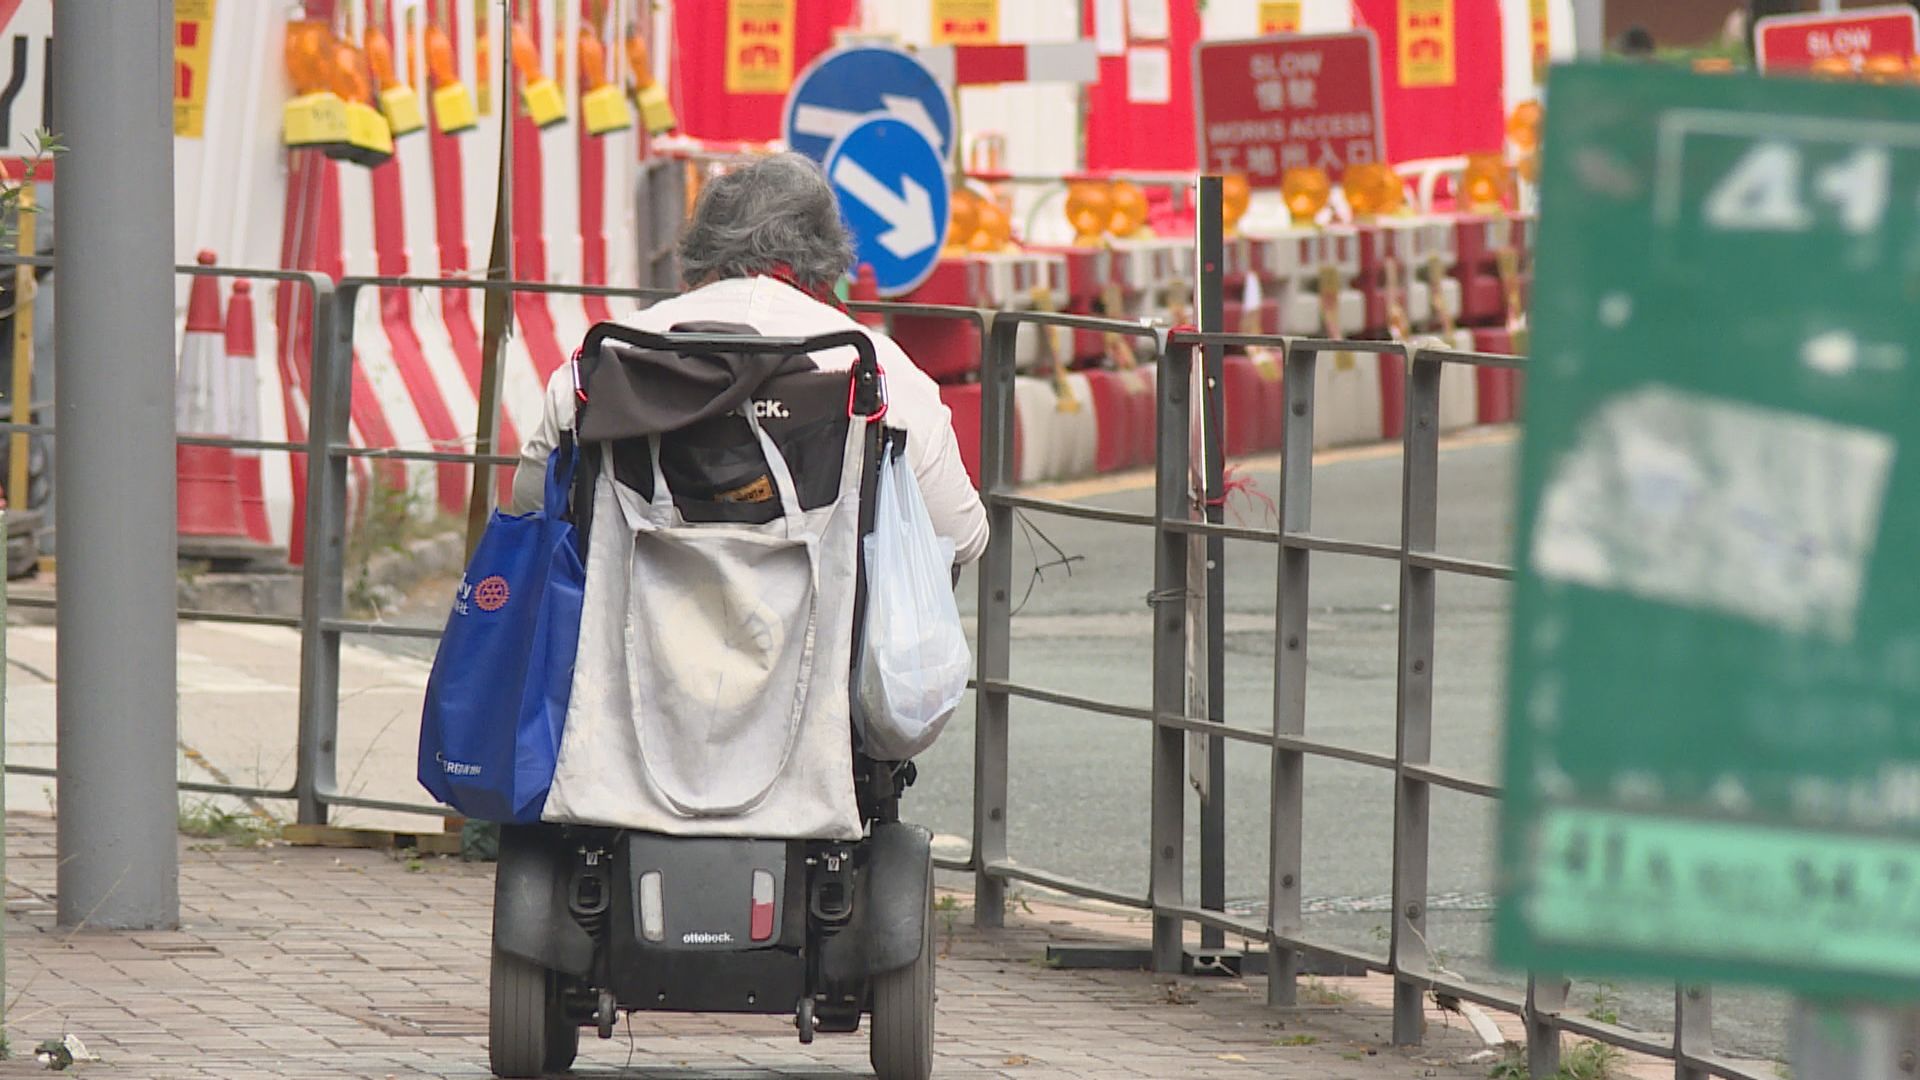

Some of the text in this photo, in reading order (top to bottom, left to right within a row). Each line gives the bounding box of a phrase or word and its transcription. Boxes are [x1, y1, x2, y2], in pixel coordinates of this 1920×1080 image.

[1806, 27, 1871, 56] SLOW
[1250, 52, 1322, 79] SLOW
[1209, 112, 1371, 144] WORKS ACCESS
[1705, 141, 1888, 231] 41
[683, 931, 734, 944] ottobock.
